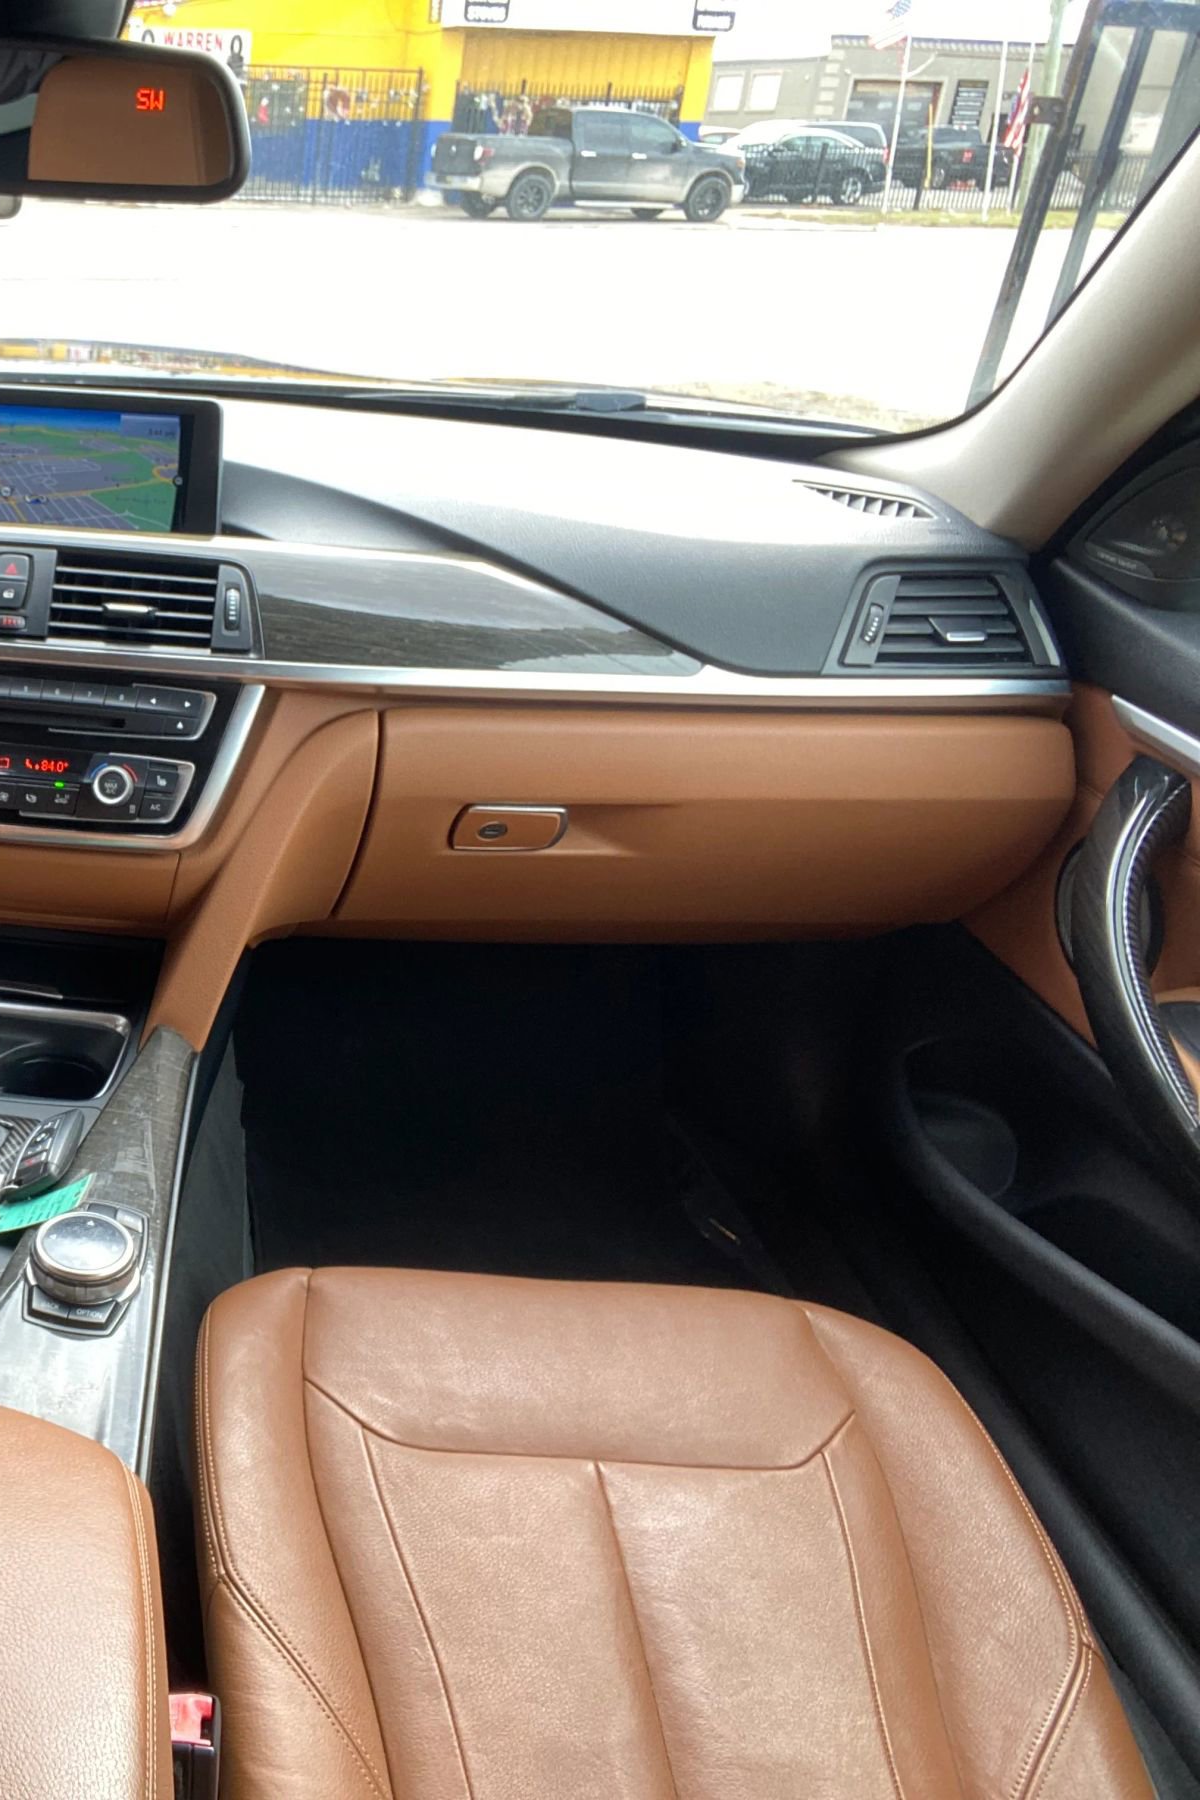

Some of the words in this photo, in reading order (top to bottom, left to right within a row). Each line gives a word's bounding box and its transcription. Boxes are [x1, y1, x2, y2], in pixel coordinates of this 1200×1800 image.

[164, 31, 222, 52] WARREN
[136, 88, 164, 110] SW
[76, 1308, 103, 1318] OPTION
